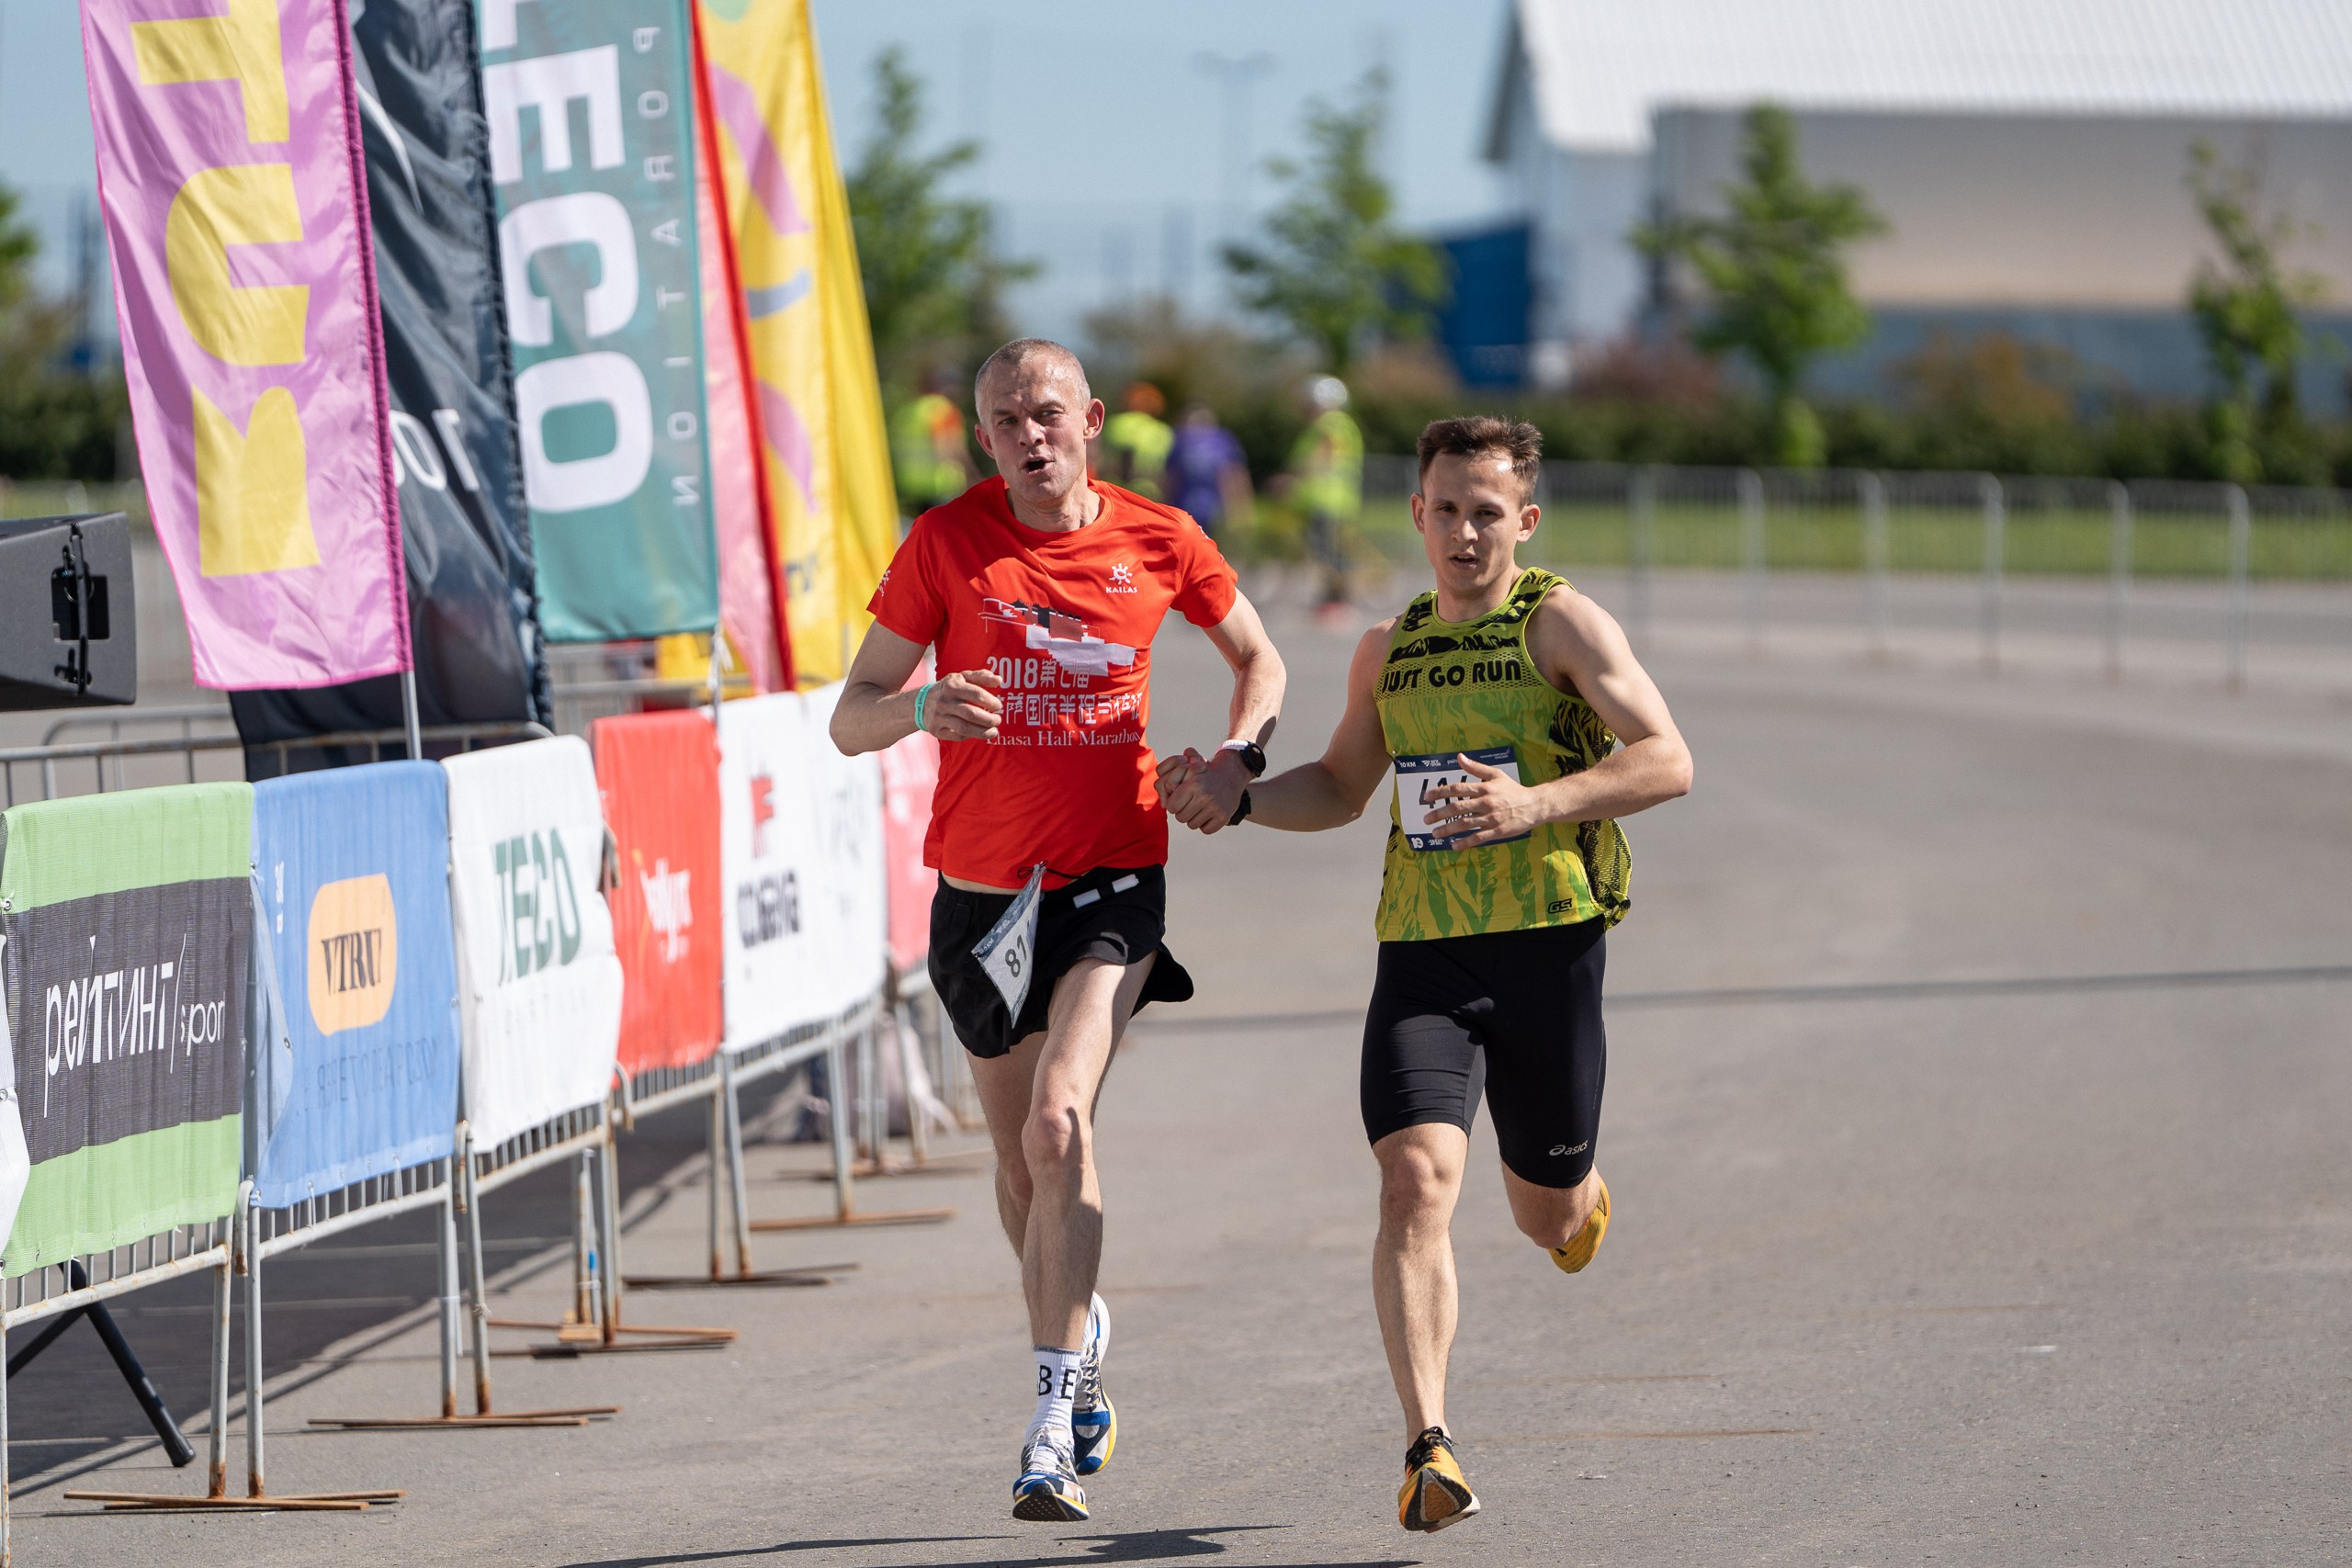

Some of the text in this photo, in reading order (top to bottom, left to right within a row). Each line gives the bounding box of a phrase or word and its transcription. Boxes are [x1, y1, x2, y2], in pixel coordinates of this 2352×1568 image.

[1105, 585, 1138, 593] KAILAS
[1382, 659, 1522, 694] JUST GO RUN
[1037, 730, 1075, 746] Half
